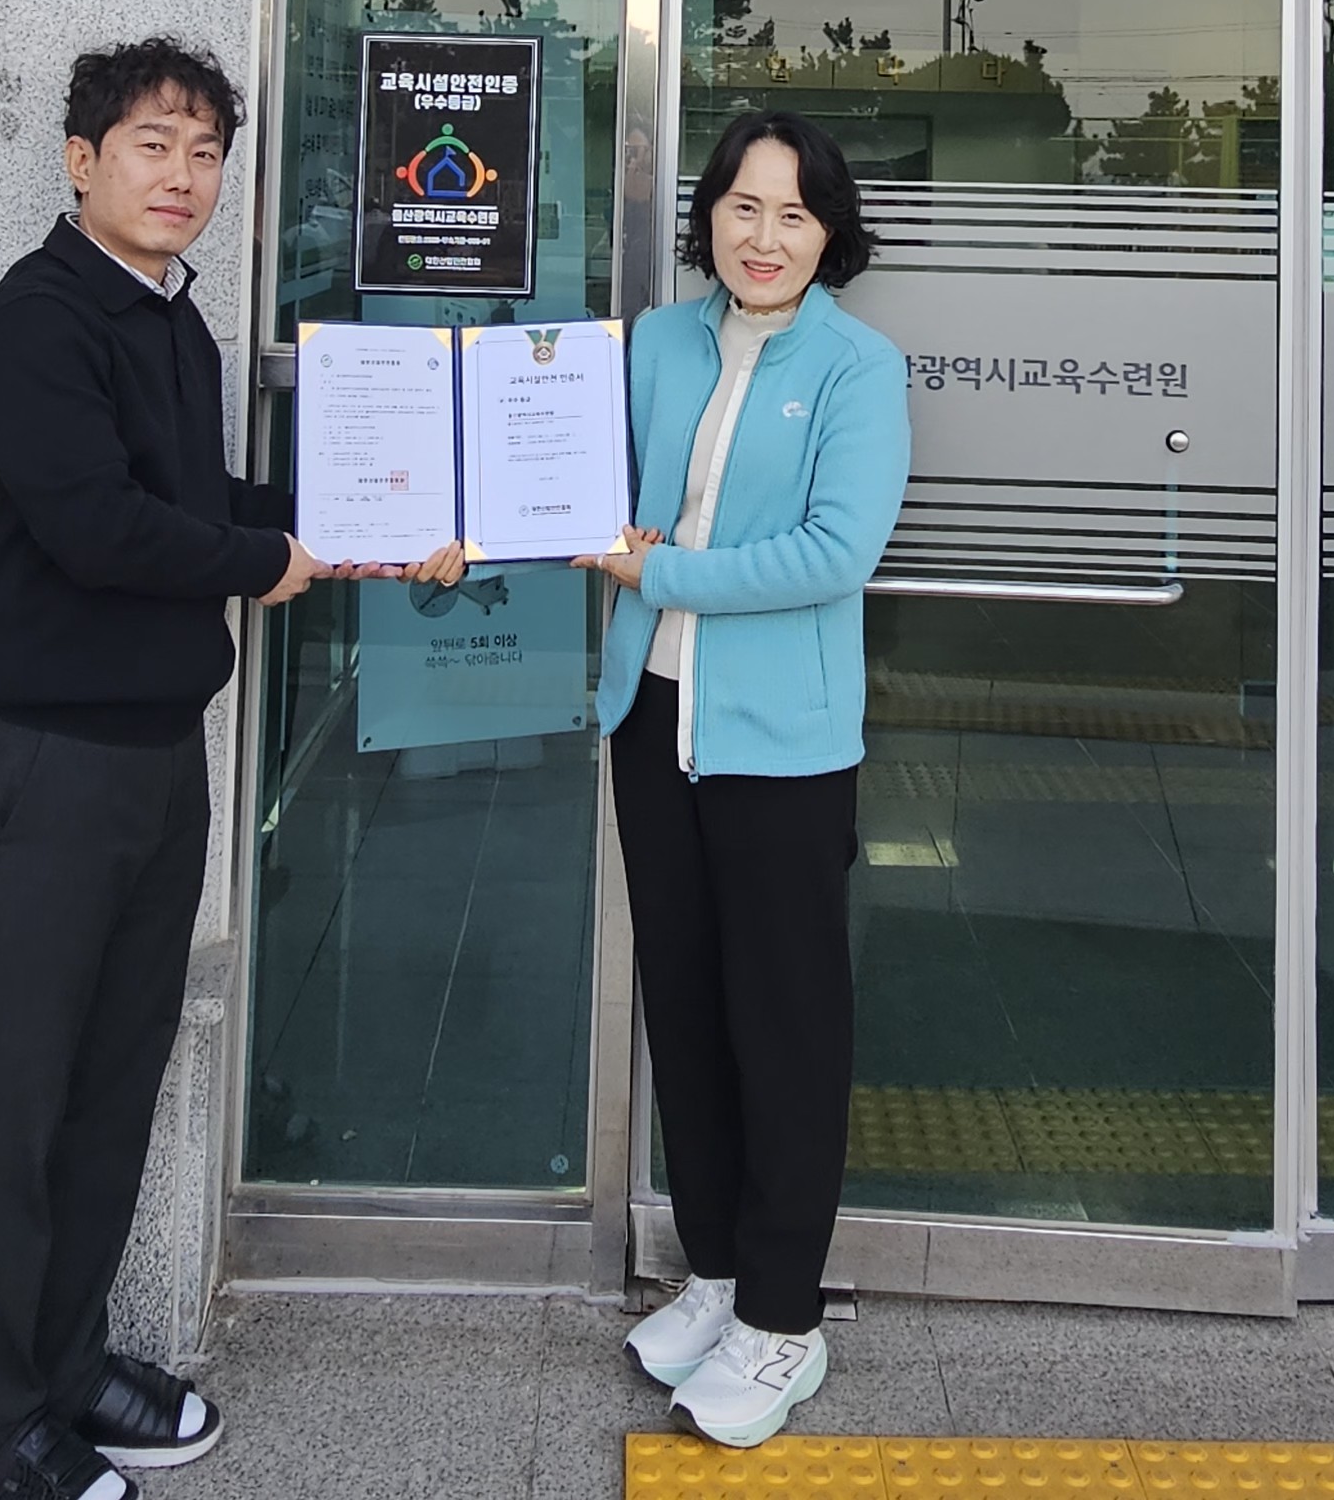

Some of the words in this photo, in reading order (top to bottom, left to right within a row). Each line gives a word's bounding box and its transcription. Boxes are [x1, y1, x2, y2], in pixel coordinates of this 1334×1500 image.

[380, 72, 518, 94] 교육시설안전인증
[415, 94, 481, 111] (우수등급)
[470, 635, 489, 649] 5회
[494, 633, 517, 648] 이상
